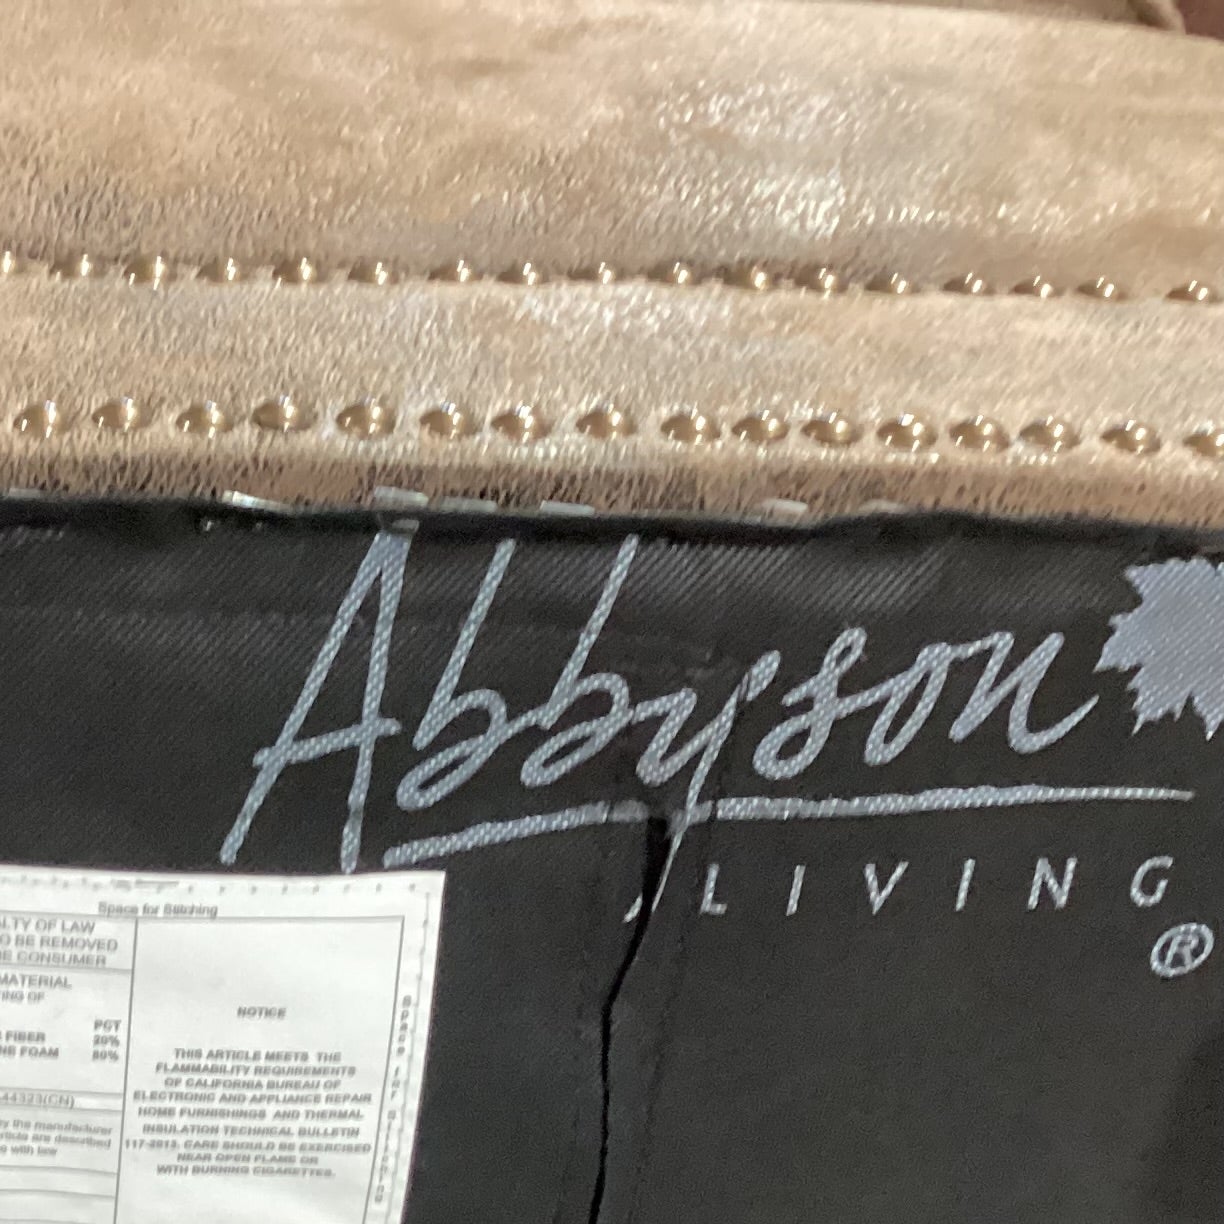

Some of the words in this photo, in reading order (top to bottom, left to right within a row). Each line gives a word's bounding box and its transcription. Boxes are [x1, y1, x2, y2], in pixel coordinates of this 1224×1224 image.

[219, 533, 1100, 922] Abbyson
[700, 855, 1174, 916] LIVING
[98, 901, 138, 917] Space
[142, 902, 160, 915] for
[35, 918, 57, 932] OF
[61, 920, 95, 934] LAW
[15, 933, 35, 947] BE
[40, 934, 118, 952] REMOVED
[16, 950, 107, 966] CONSUMER
[28, 990, 45, 1003] OF
[236, 1006, 287, 1020] NOTICE
[5, 1029, 46, 1043] FIBER
[20, 1045, 59, 1059] FOAM
[174, 1047, 203, 1060] THIS
[206, 1049, 261, 1062] ARTICLE
[265, 1050, 309, 1063] MEETS
[317, 1051, 342, 1063] THE
[156, 1062, 250, 1076] FLAMMABILITY
[185, 1077, 263, 1090] CALIFORNIA
[219, 1092, 246, 1105] AND
[273, 1107, 300, 1120] AND
[304, 1107, 364, 1120] THERMAL
